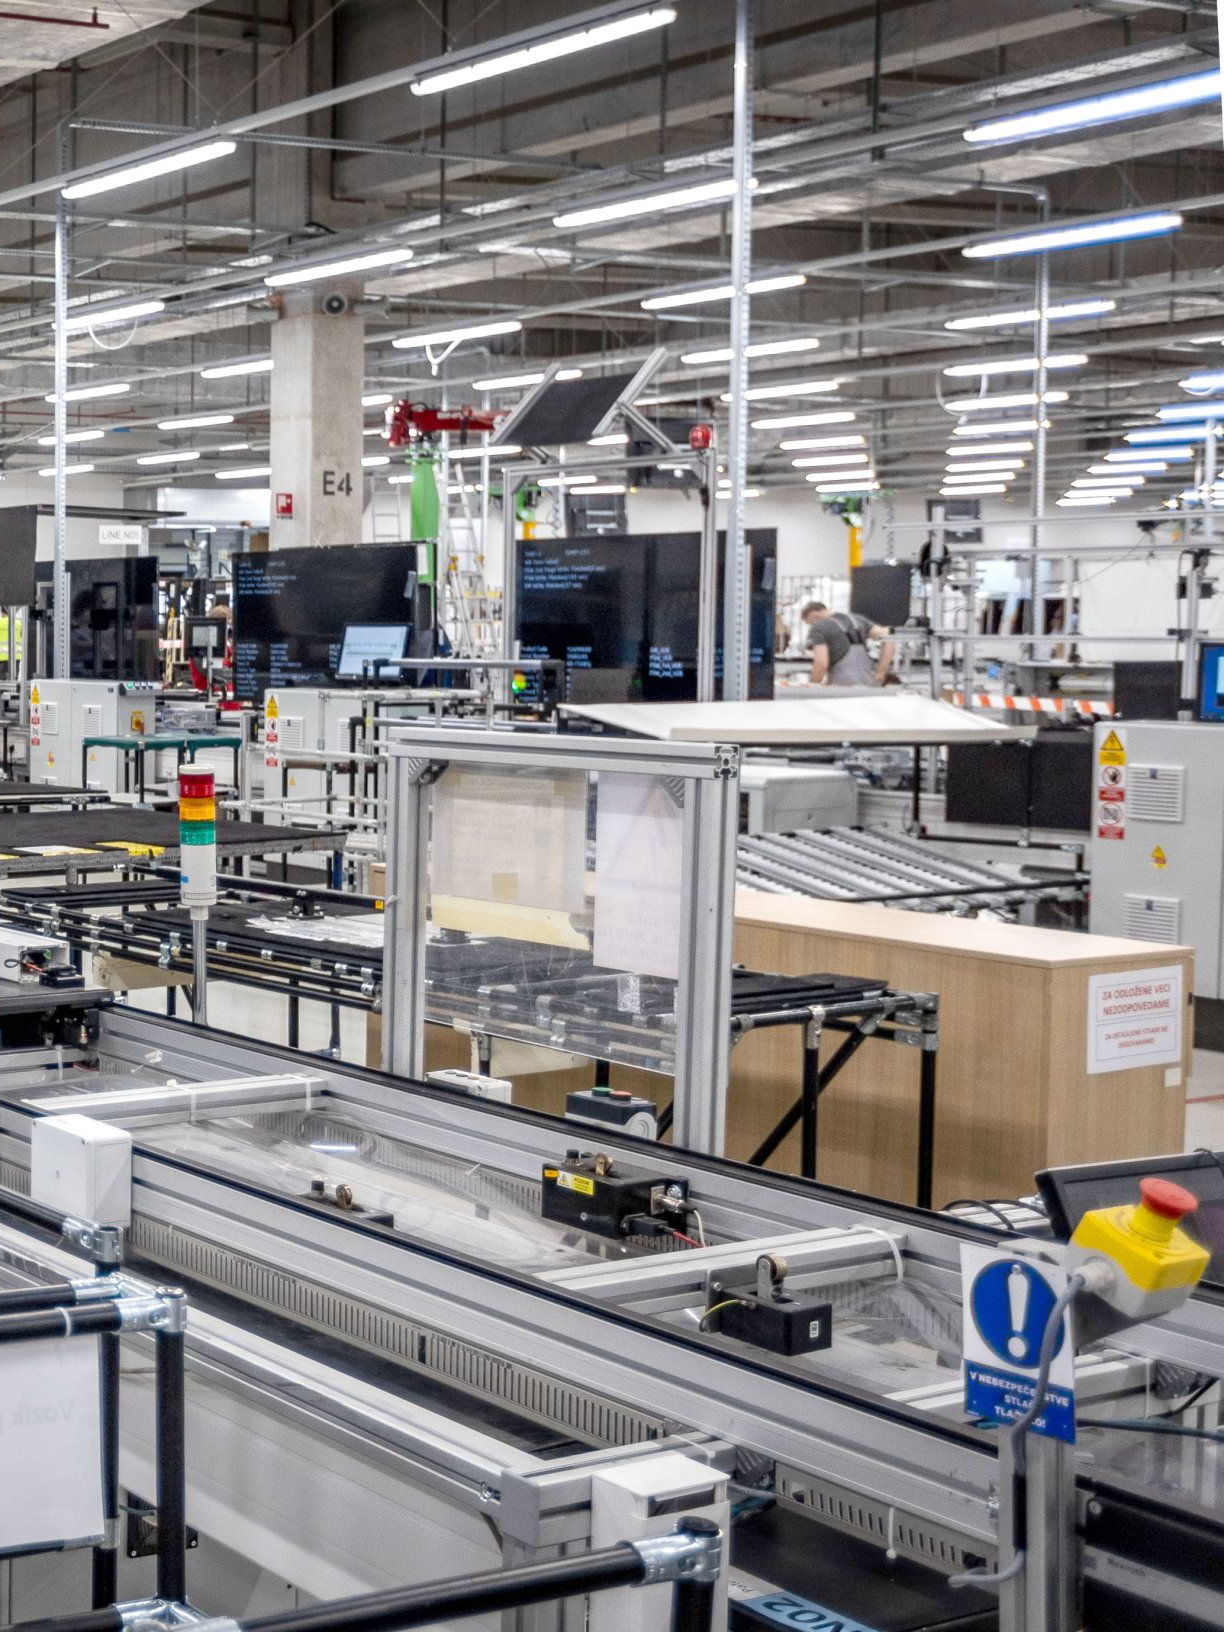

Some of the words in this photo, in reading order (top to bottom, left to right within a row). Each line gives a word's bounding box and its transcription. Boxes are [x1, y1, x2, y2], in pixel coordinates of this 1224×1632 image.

[322, 470, 353, 497] E4
[101, 529, 121, 540] LINE
[1102, 991, 1112, 1001] ZA
[1113, 985, 1153, 999] ODLOŽENE
[1154, 983, 1171, 994] VECI
[1102, 998, 1170, 1016] NEZODPOVEDAME
[969, 1371, 977, 1380] V
[978, 1374, 1069, 1407] NEBEZPEČESTVE
